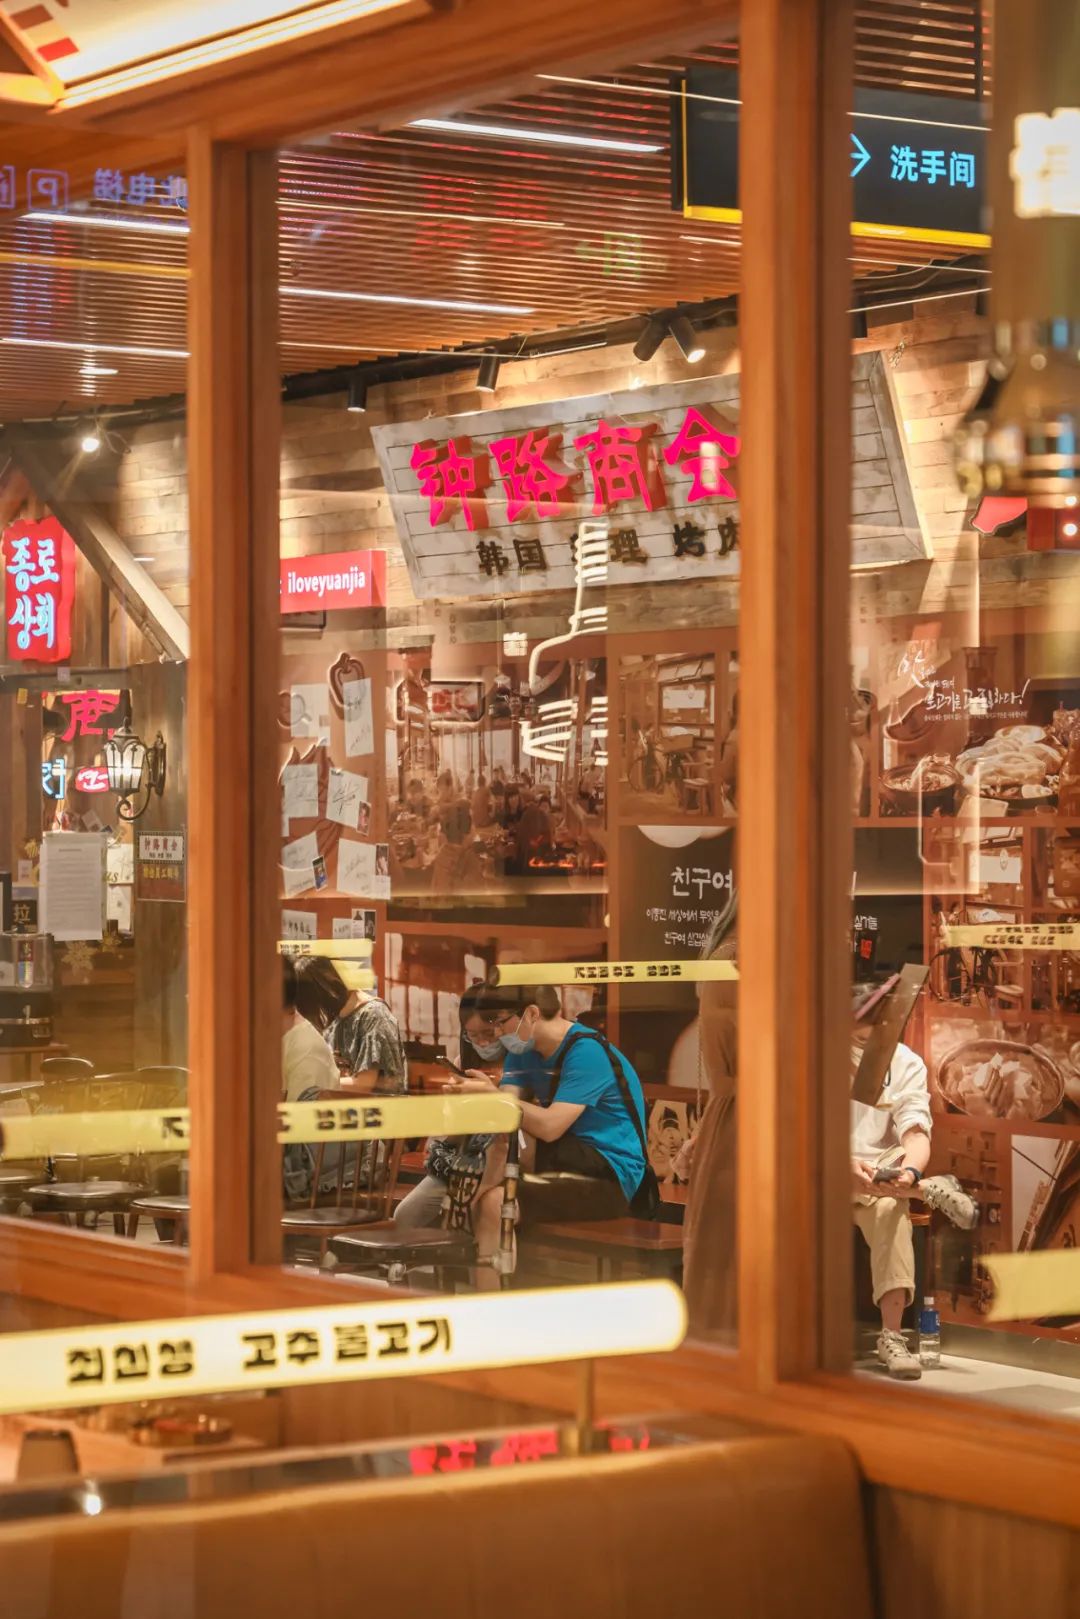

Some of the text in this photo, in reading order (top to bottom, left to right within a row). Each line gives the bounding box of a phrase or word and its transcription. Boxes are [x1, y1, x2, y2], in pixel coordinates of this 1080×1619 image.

[890, 144, 975, 188] 洗手间
[410, 406, 740, 532] 钟路商会
[7, 536, 59, 592] 종로
[287, 565, 366, 597] iloveyuanjia
[8, 592, 55, 649] 상회
[242, 1317, 453, 1370] 고추불고기
